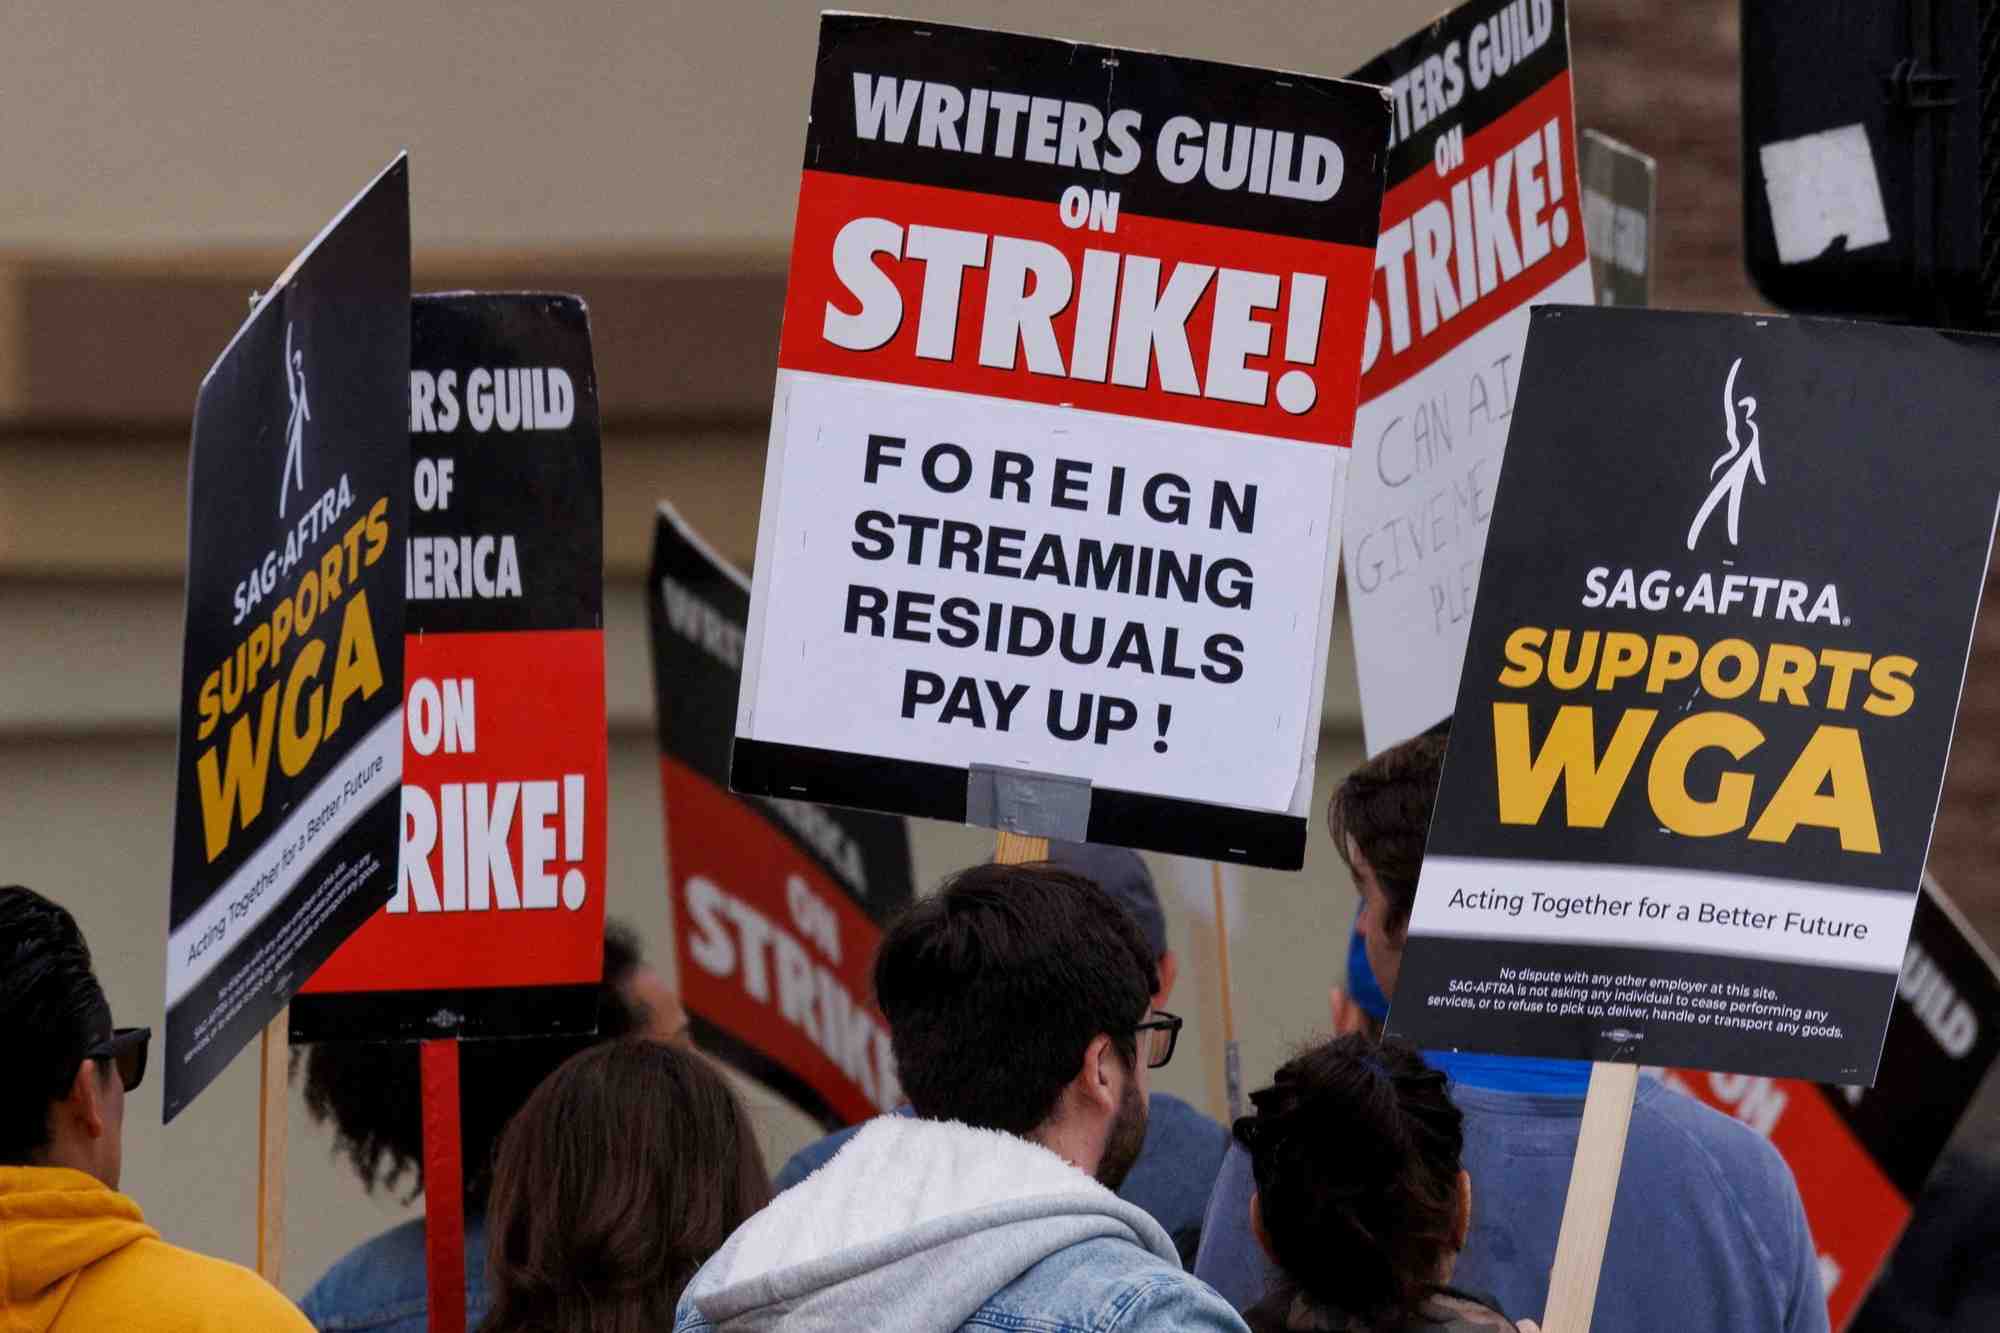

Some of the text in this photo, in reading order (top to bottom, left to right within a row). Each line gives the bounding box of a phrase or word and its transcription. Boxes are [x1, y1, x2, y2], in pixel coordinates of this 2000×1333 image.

[1468, 0, 1552, 90] GUILD
[852, 72, 1344, 202] WRITERS GUILD
[1435, 122, 1464, 177] ON
[1059, 185, 1120, 233] ON
[822, 216, 1327, 415] STRIKE!
[408, 367, 575, 432] RS GUILD
[1377, 354, 1513, 488] CAN AI
[414, 457, 454, 511] OF
[863, 434, 1258, 534] FOREIGN
[405, 535, 523, 600] ERICA
[851, 509, 1254, 610] STREAMING
[197, 496, 388, 742] SUPPORTS
[843, 583, 1244, 684] RESIDUALS
[407, 677, 475, 756] ON
[900, 668, 1030, 732] PAY
[1498, 626, 1919, 717] SUPPORTS
[197, 588, 383, 864] WGA
[1492, 701, 1882, 854] WGA
[187, 918, 226, 966] Acting
[227, 862, 280, 923] Together
[281, 843, 298, 870] for
[307, 796, 342, 842] Better
[343, 756, 383, 804] Future
[1448, 888, 1869, 940] Acting Together for a Better Future
[1427, 994, 1476, 1010] services,
[1479, 999, 1491, 1010] or
[1494, 999, 1506, 1010] to
[1507, 1000, 1543, 1013] refuse
[1546, 1001, 1558, 1014] to
[1560, 1002, 1584, 1016] pick
[1607, 1005, 1649, 1020] deliver,
[1652, 1007, 1695, 1023] handle
[1698, 1013, 1712, 1024] or
[1714, 1015, 1774, 1032] transport
[1776, 1022, 1799, 1036] any
[1802, 1024, 1844, 1039] goods.
[1499, 967, 1778, 1000] No dispute with any other employer at this site.
[1517, 984, 1526, 997] is
[1529, 986, 1548, 998] not
[1551, 986, 1588, 1001] asking
[1592, 990, 1613, 1003] any
[1615, 989, 1673, 1006] individual
[1676, 995, 1689, 1007] to
[1691, 998, 1727, 1011] cease
[1729, 1000, 1802, 1020] performing
[1804, 1010, 1828, 1024] any
